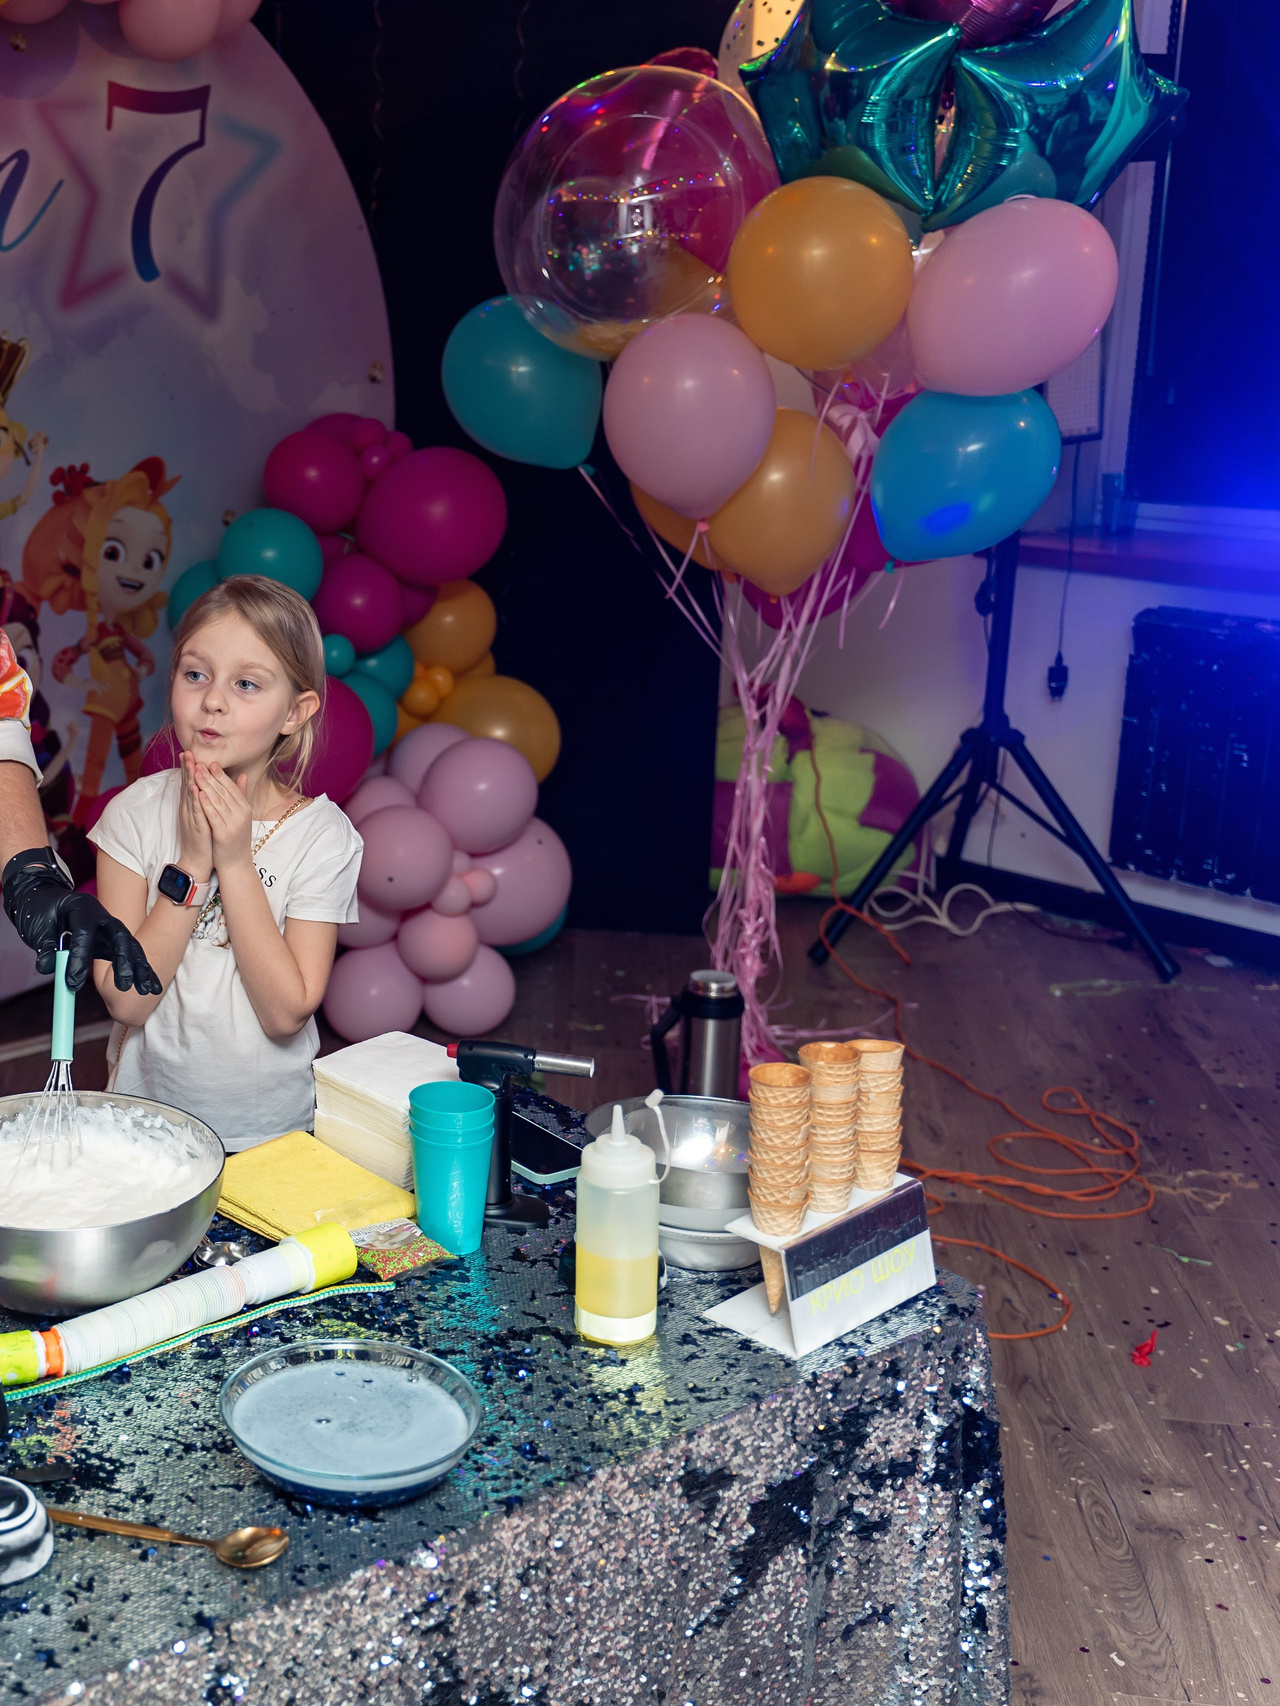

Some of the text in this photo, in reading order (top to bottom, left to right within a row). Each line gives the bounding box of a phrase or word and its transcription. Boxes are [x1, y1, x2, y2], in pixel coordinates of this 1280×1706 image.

[107, 80, 211, 283] 7
[809, 1240, 916, 1316] КРИО ШОУ
